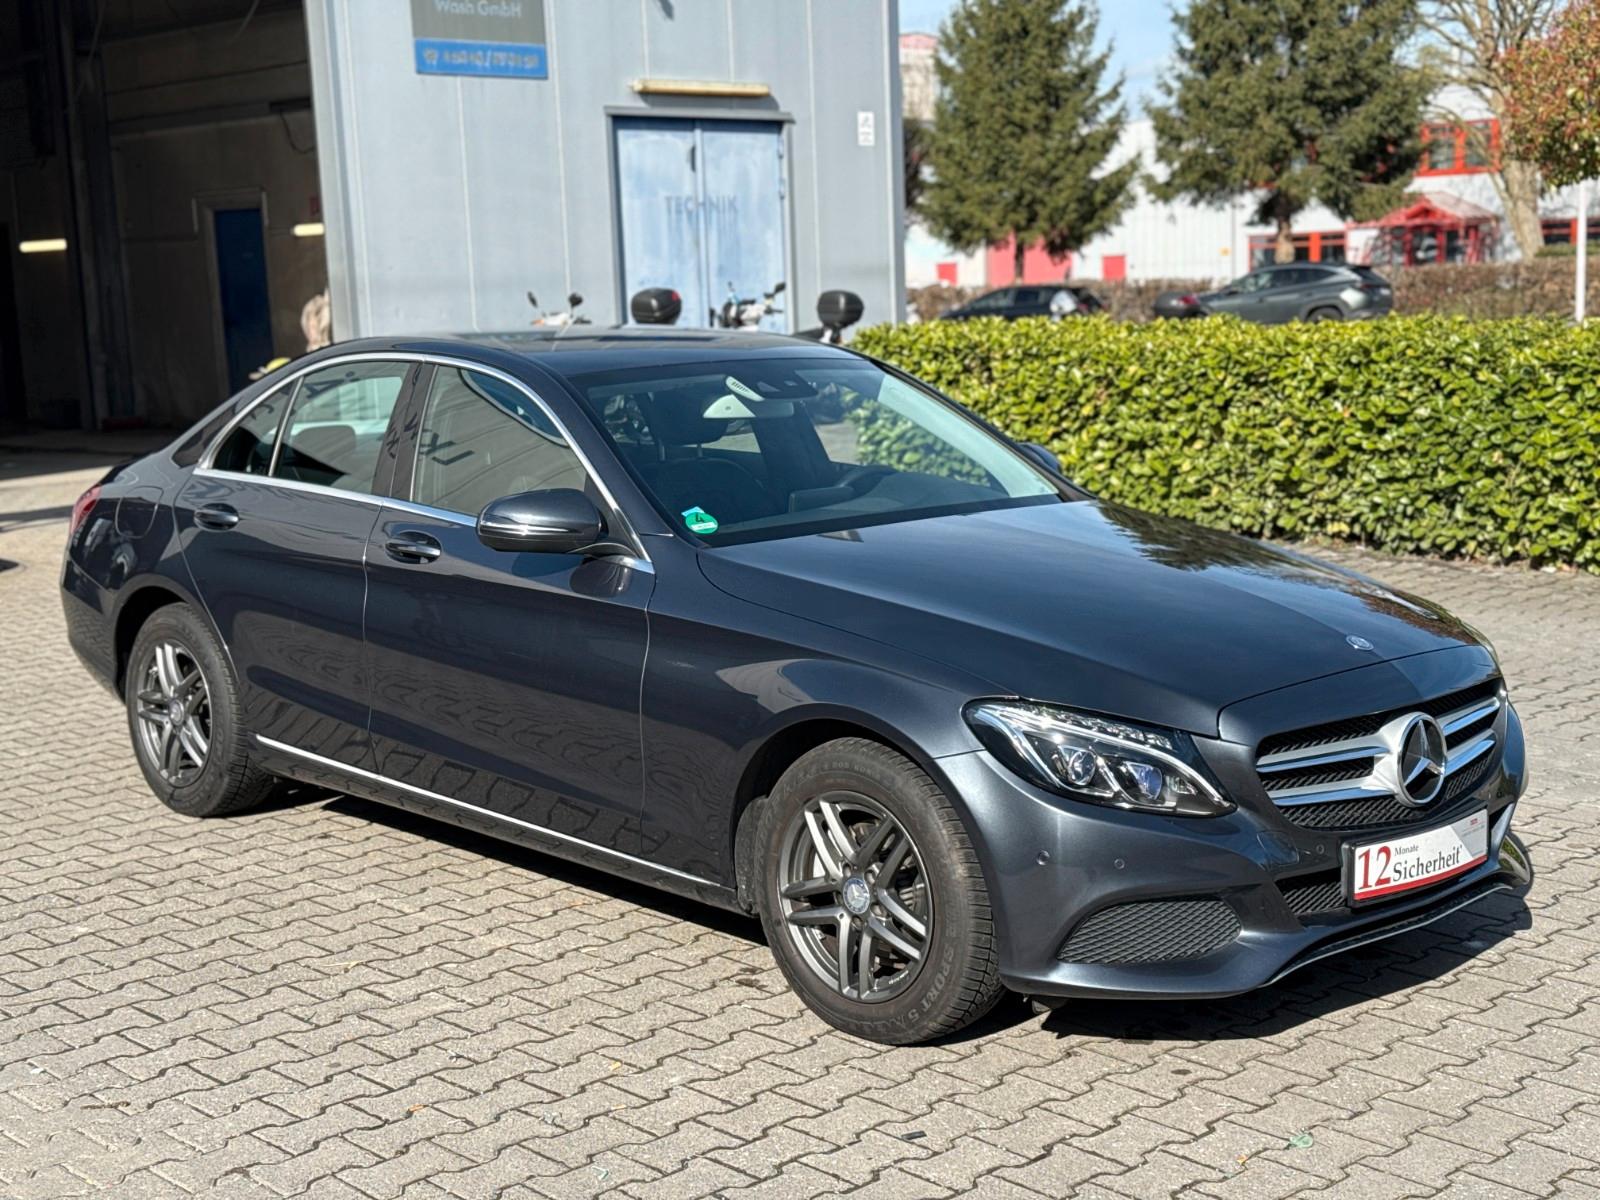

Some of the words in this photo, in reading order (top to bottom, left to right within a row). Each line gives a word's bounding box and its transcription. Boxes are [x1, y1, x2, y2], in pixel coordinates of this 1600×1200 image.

[435, 0, 475, 15] Wash
[478, 0, 522, 18] GmbH
[664, 195, 738, 217] TECHNIK
[1394, 844, 1419, 856] Monate
[1358, 845, 1392, 890] 12
[920, 943, 954, 1012] SPORT
[908, 1008, 920, 1023] 5
